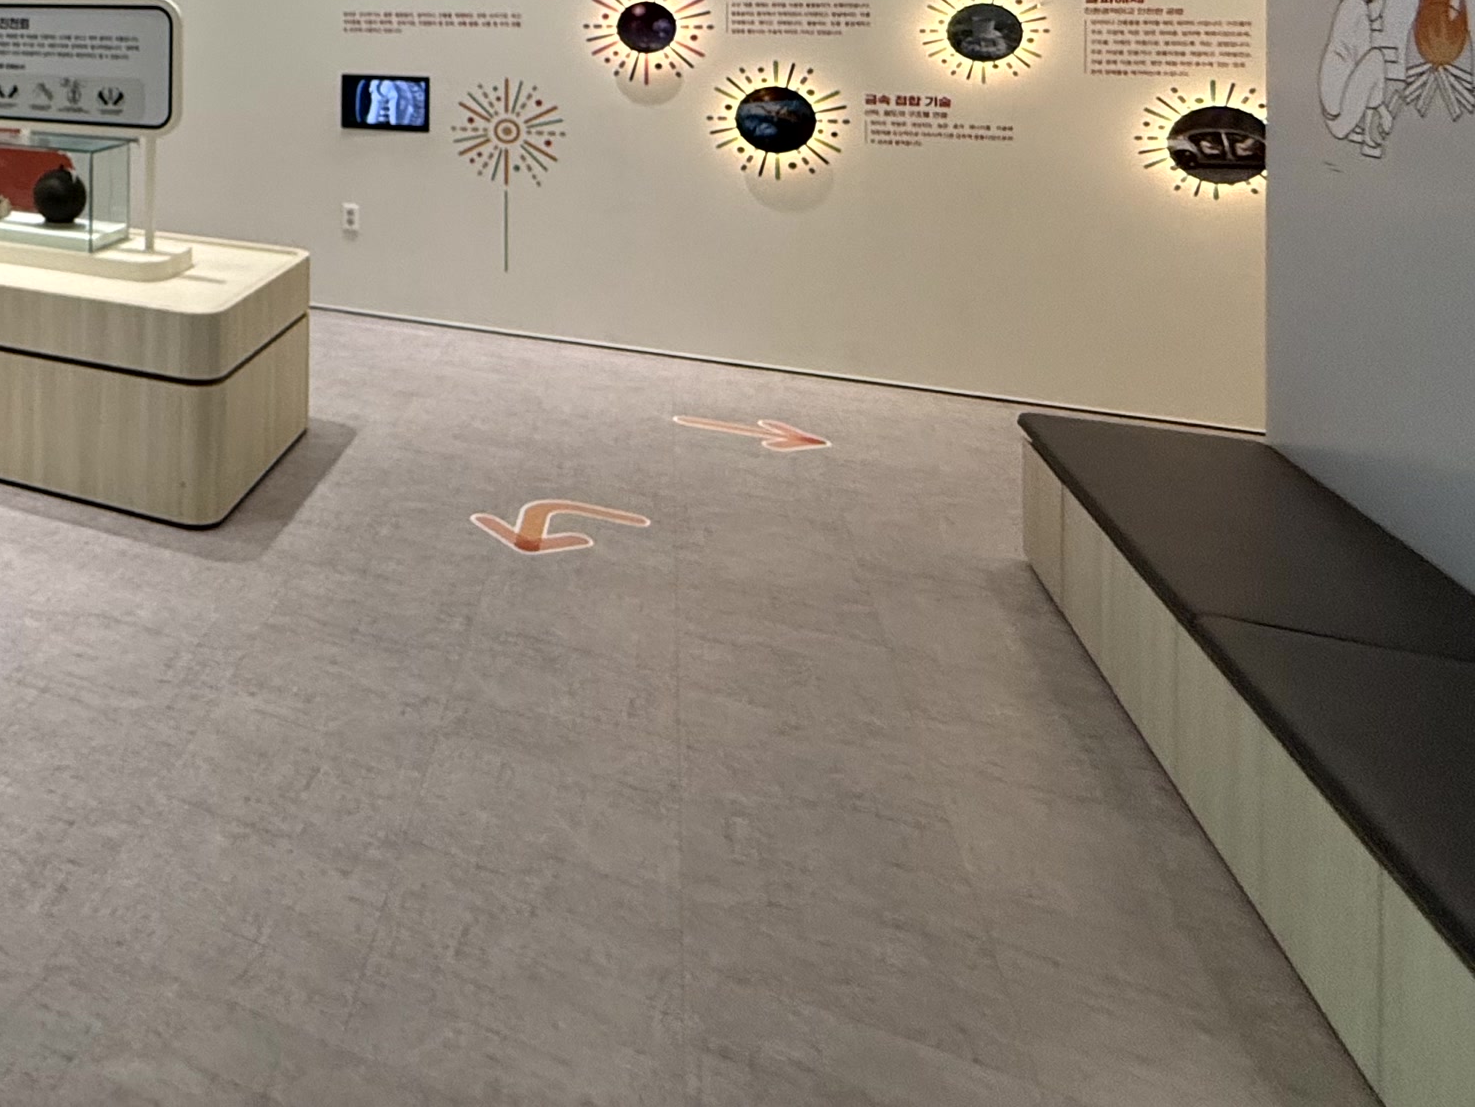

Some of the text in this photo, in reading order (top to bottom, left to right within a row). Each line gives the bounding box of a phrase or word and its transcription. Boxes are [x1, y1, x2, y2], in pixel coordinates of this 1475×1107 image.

[865, 94, 951, 108] 금속 접합 기술
